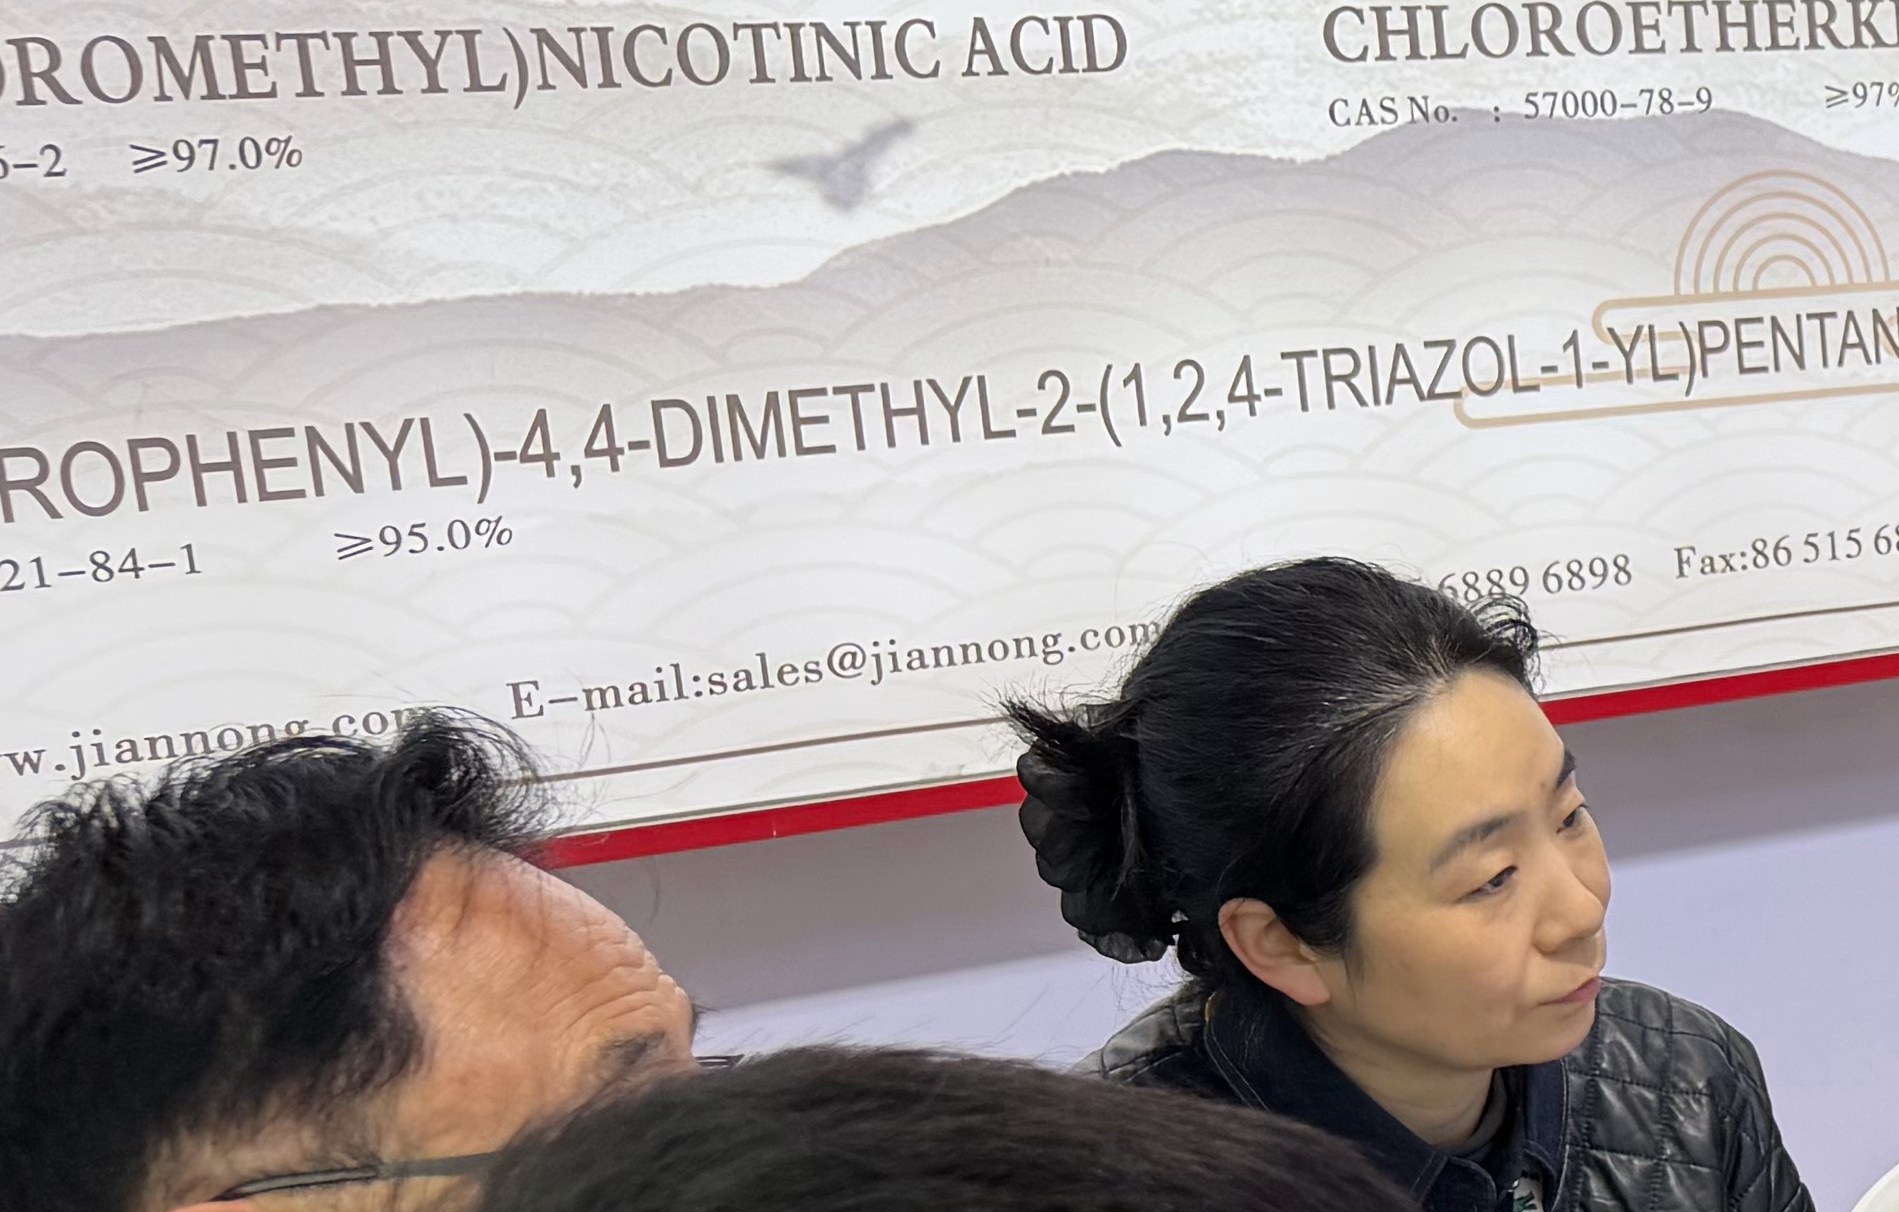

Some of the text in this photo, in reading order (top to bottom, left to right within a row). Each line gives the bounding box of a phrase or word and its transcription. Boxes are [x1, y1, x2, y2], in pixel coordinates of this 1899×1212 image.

[0, 14, 1128, 109] ROMETHYL)NICOTINIC ACID
[1329, 99, 1399, 127] CAS
[1408, 95, 1458, 125] No.
[1523, 86, 1713, 120] 57000-78-9
[1542, 553, 1632, 596] 6898
[1673, 535, 1793, 581] Fax:86
[1802, 526, 1863, 564] 515
